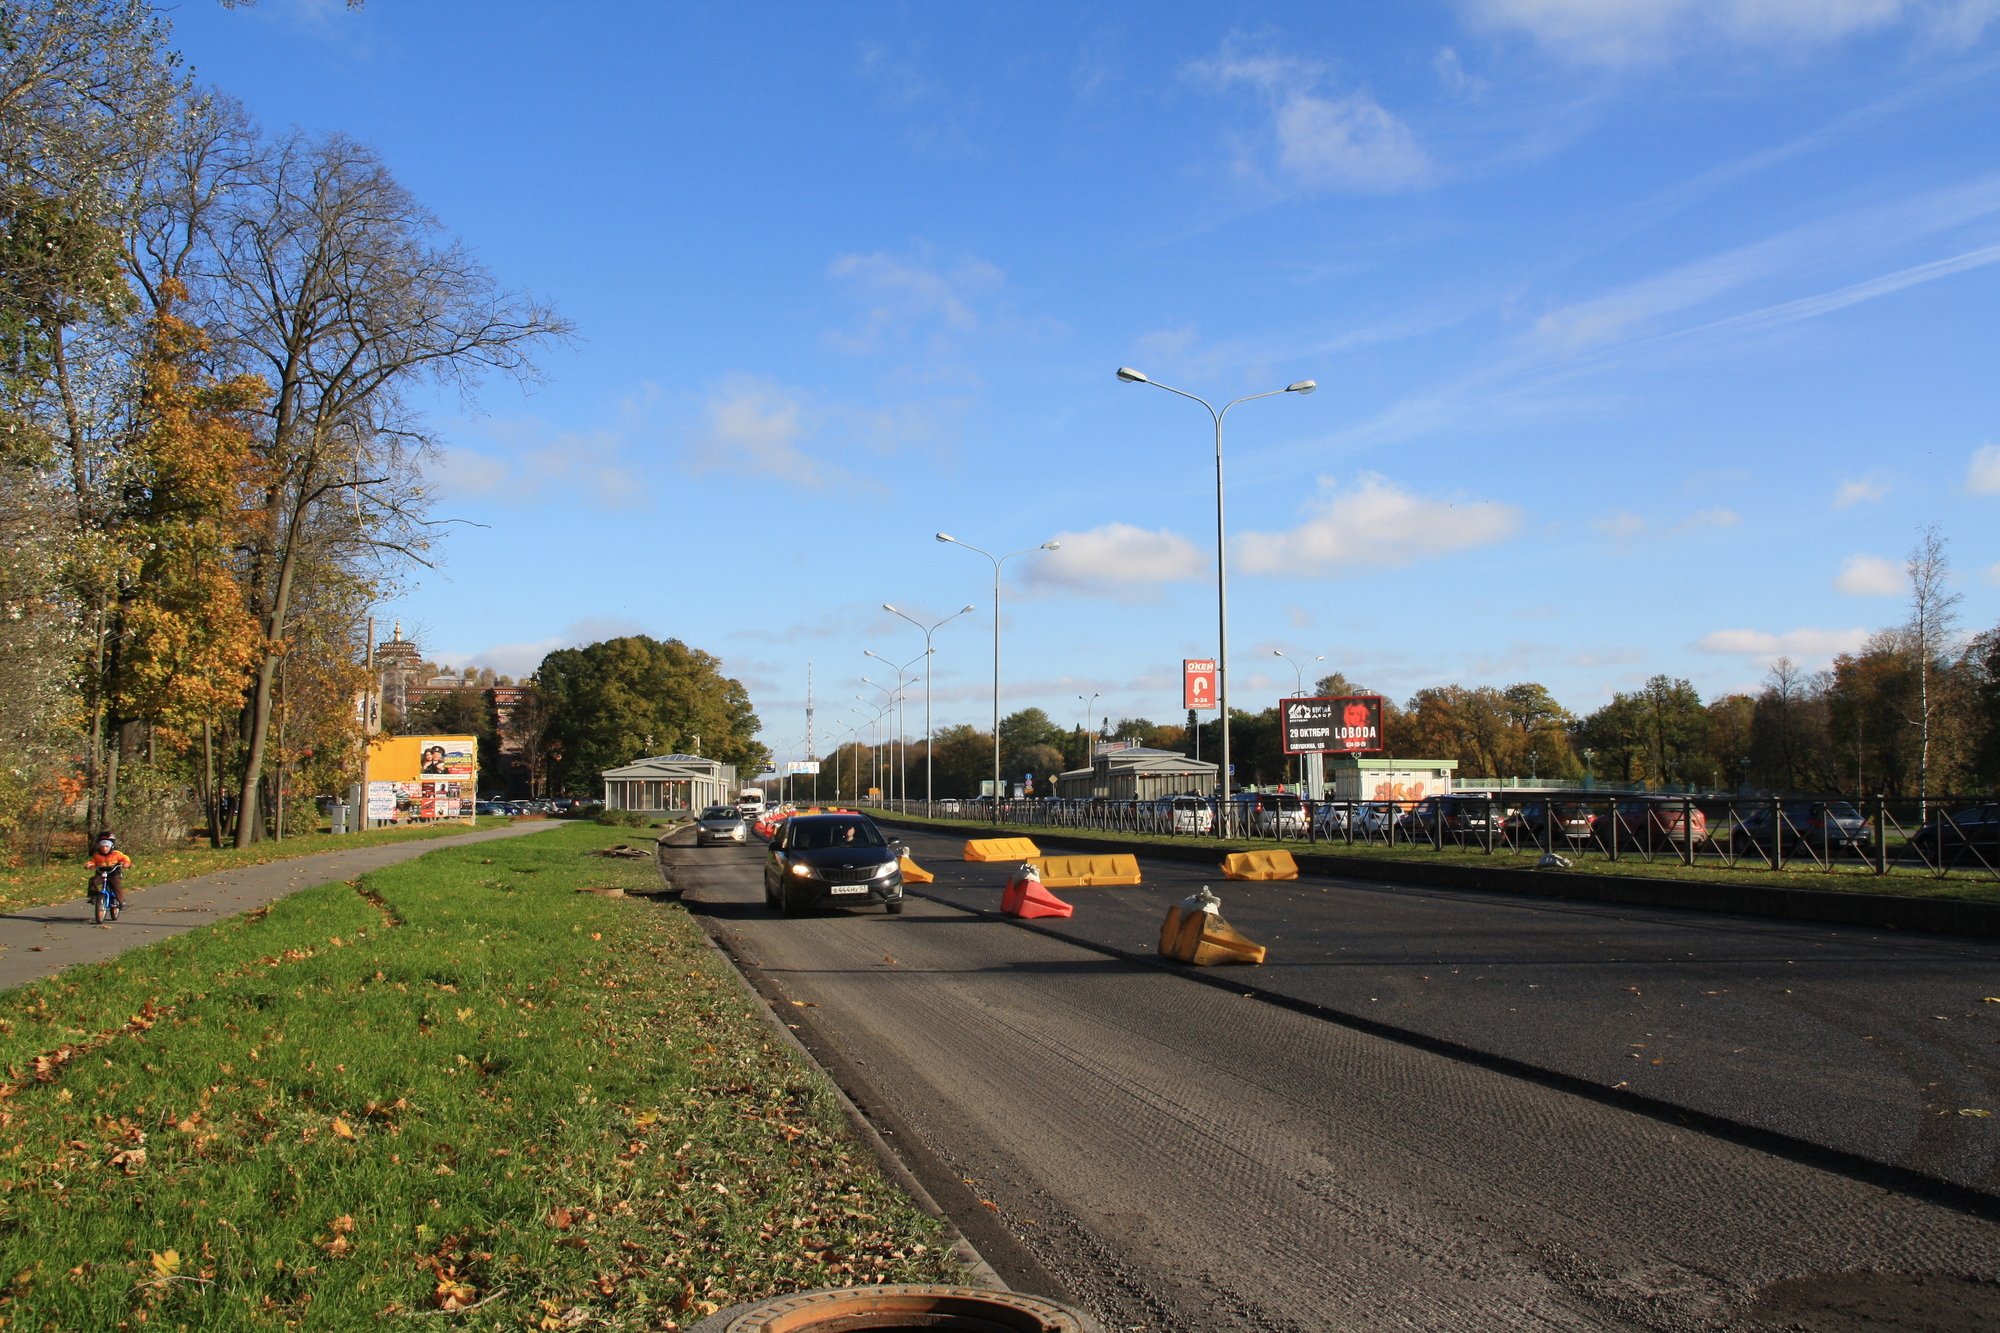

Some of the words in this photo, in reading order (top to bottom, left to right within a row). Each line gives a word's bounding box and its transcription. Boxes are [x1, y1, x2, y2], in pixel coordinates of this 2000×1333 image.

[1289, 728, 1299, 738] 29
[1299, 727, 1330, 738] ОКТЯБРЯ
[1334, 726, 1377, 739] LOBODA
